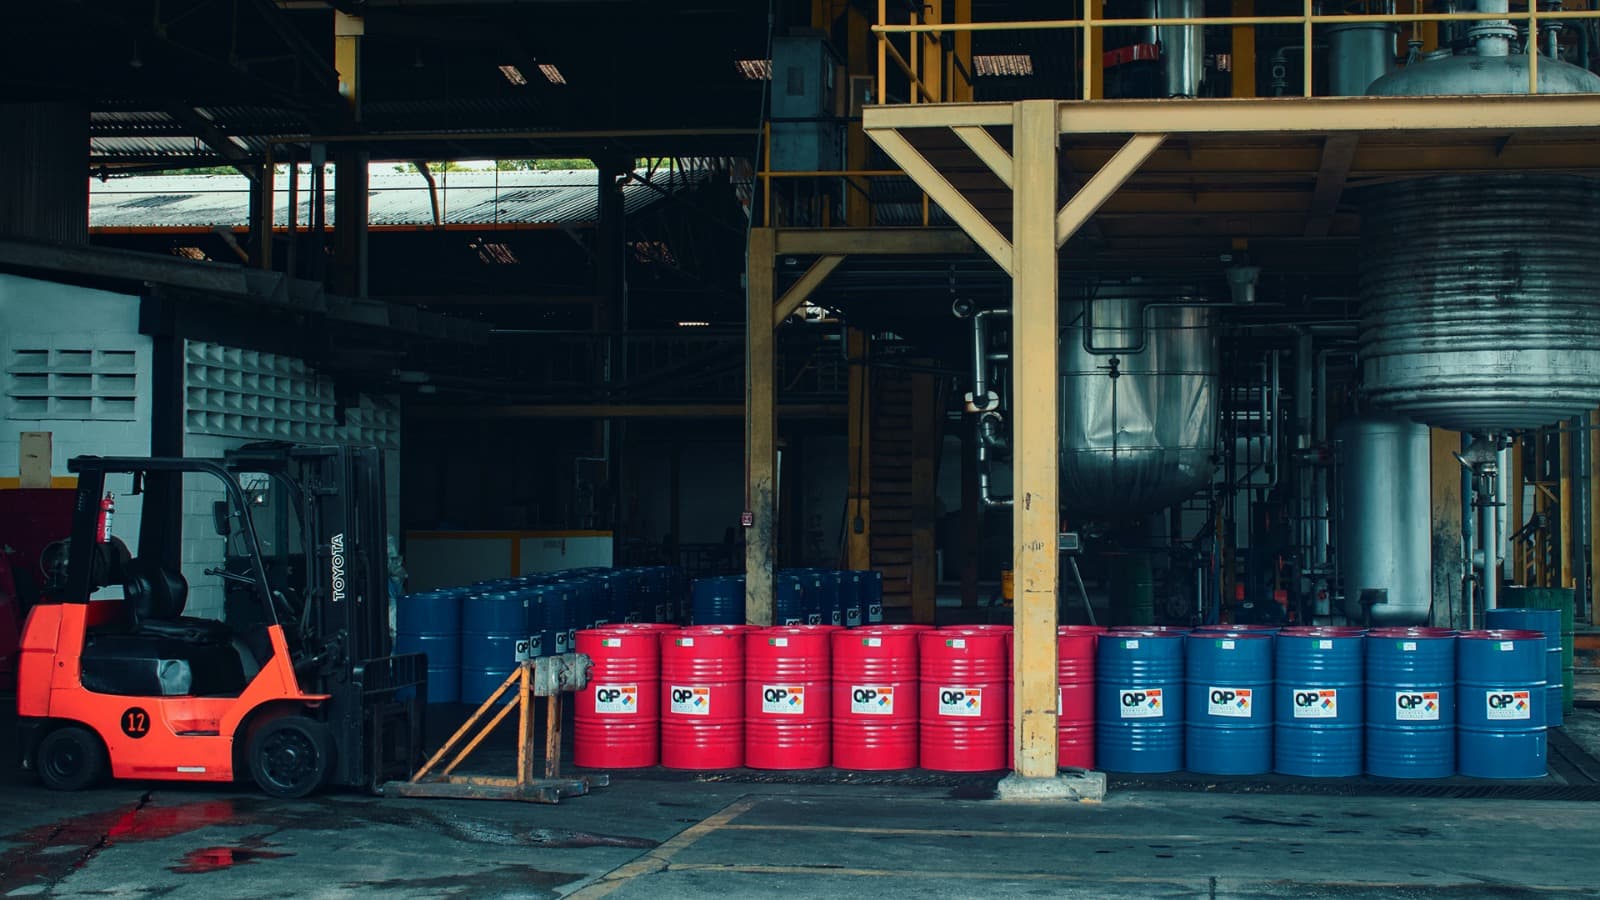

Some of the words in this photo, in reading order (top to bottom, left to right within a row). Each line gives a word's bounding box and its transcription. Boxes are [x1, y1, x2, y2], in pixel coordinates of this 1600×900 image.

[331, 533, 345, 602] TOYOTA
[597, 689, 621, 703] QP
[673, 689, 693, 703] QP
[764, 689, 787, 703] QP
[854, 689, 877, 703] QP
[942, 691, 964, 705] QP
[1122, 692, 1146, 707] QP
[1212, 690, 1235, 705] QP
[1295, 692, 1319, 707] QP
[1398, 695, 1422, 709] QP
[1488, 694, 1513, 709] QP
[128, 713, 145, 732] 12
